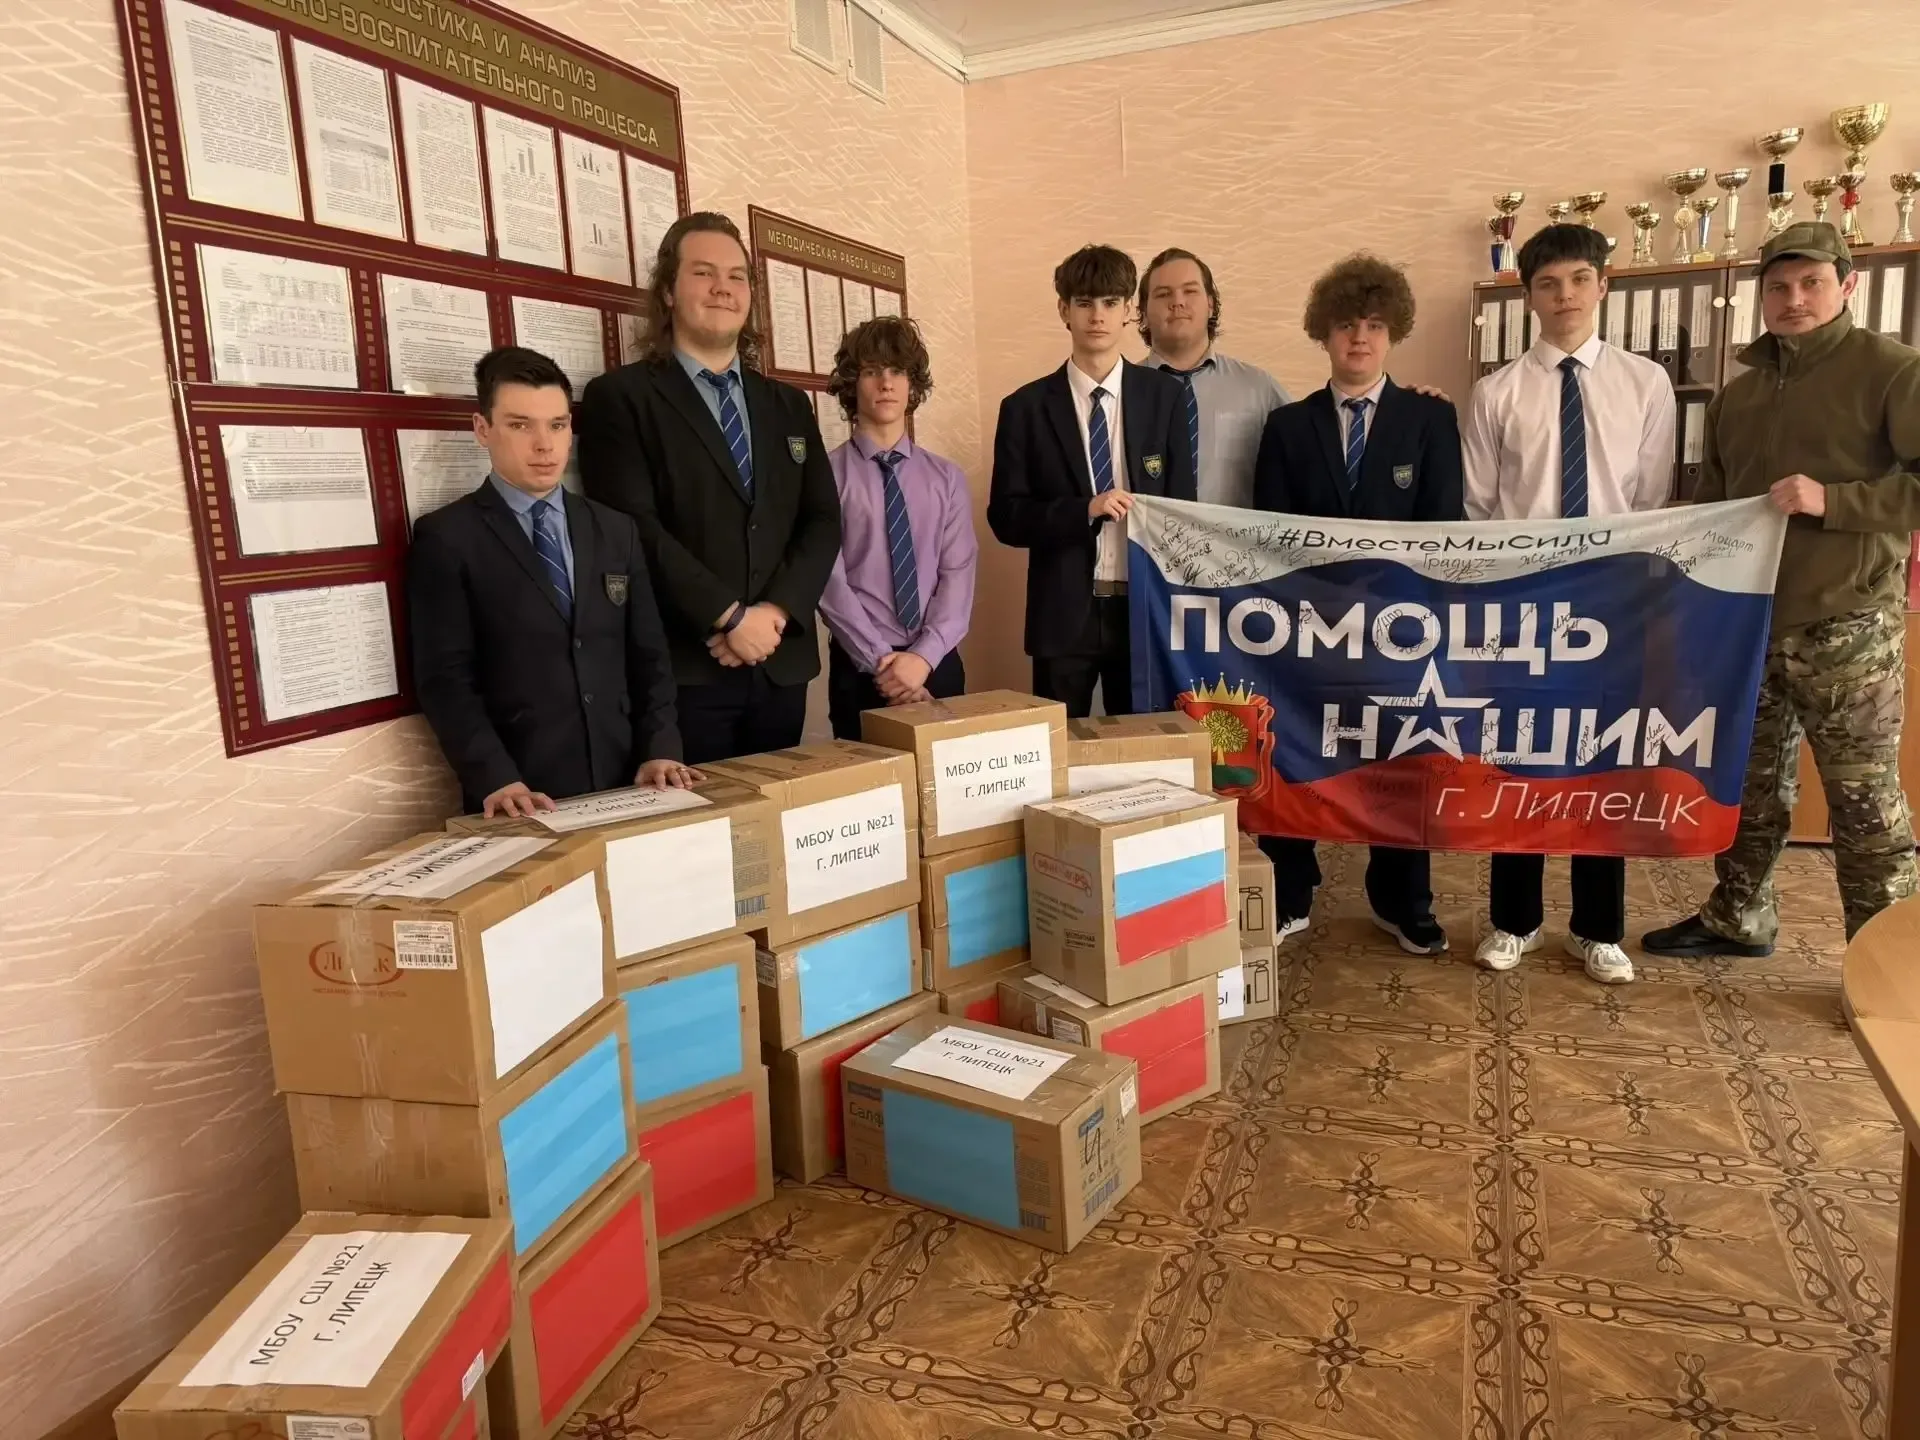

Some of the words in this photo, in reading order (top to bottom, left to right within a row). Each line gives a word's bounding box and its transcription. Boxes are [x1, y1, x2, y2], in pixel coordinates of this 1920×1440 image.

[493, 29, 510, 57] И
[519, 42, 597, 92] АНАЛИЗ
[571, 95, 659, 148] ПРОЦЕССА
[768, 229, 837, 261] МЕТОДИЧЕСКАЯ
[839, 252, 869, 271] РАБОТА
[871, 263, 897, 279] ШКОЛЫ
[1277, 528, 1612, 552] #ВместеМыСила
[1170, 594, 1608, 675] ПОМОЩЬ
[946, 761, 982, 778] МБОУ
[988, 756, 1007, 770] СШ
[1014, 750, 1040, 764] №21
[978, 777, 1026, 796] ЛИПЕЦК
[1481, 782, 1707, 830] Липецк
[796, 829, 834, 849] МБОУ
[841, 822, 860, 838] СШ
[867, 814, 894, 831] №21
[830, 843, 880, 868] ЛИПЕЦК
[940, 1037, 983, 1051] МБОУ
[986, 1048, 1010, 1059] СШ
[1012, 1054, 1045, 1068] №21
[956, 1055, 1015, 1075] ЛИПЕЦК
[249, 1313, 304, 1366] МБОУ
[300, 1281, 332, 1305] СШ
[322, 1244, 364, 1277] №21
[329, 1261, 392, 1326] ЛИПЕЦК
